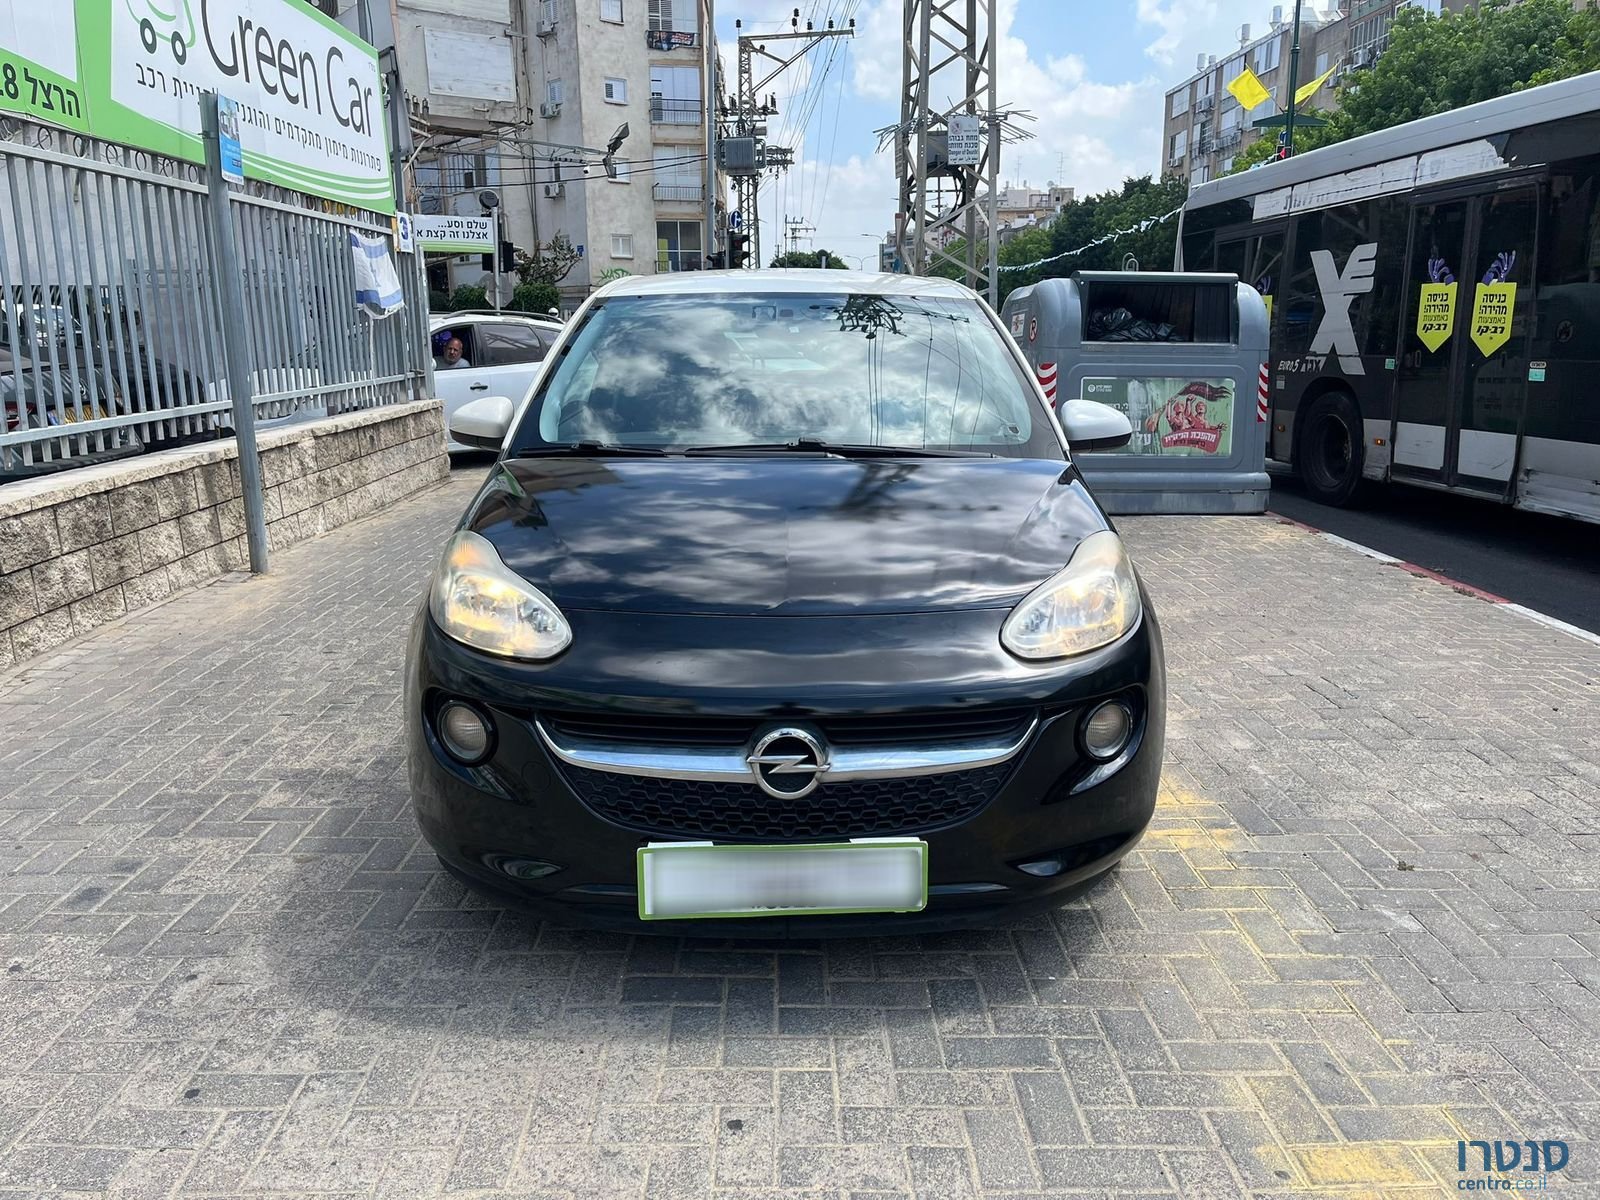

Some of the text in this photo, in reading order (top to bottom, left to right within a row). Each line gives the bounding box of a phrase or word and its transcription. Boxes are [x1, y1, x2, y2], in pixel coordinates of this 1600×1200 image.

[201, 0, 373, 137] Green Car
[136, 63, 166, 93] רכב
[23, 66, 80, 118] הרצל
[235, 101, 271, 132] והוגני
[274, 117, 322, 150] מתקדמים
[324, 136, 349, 161] מימון
[350, 147, 382, 172] פתרונות
[438, 220, 488, 230] שלם וסע...
[426, 229, 446, 241] קצת
[449, 230, 460, 239] זה
[462, 230, 488, 240] אצלנו
[1427, 292, 1449, 303] כניסה
[1482, 293, 1507, 304] כניסה
[1423, 303, 1449, 314] מהירה!
[1478, 304, 1508, 316] מהירה!
[1423, 314, 1449, 322] באמצעות
[1477, 316, 1506, 325] באמצעות
